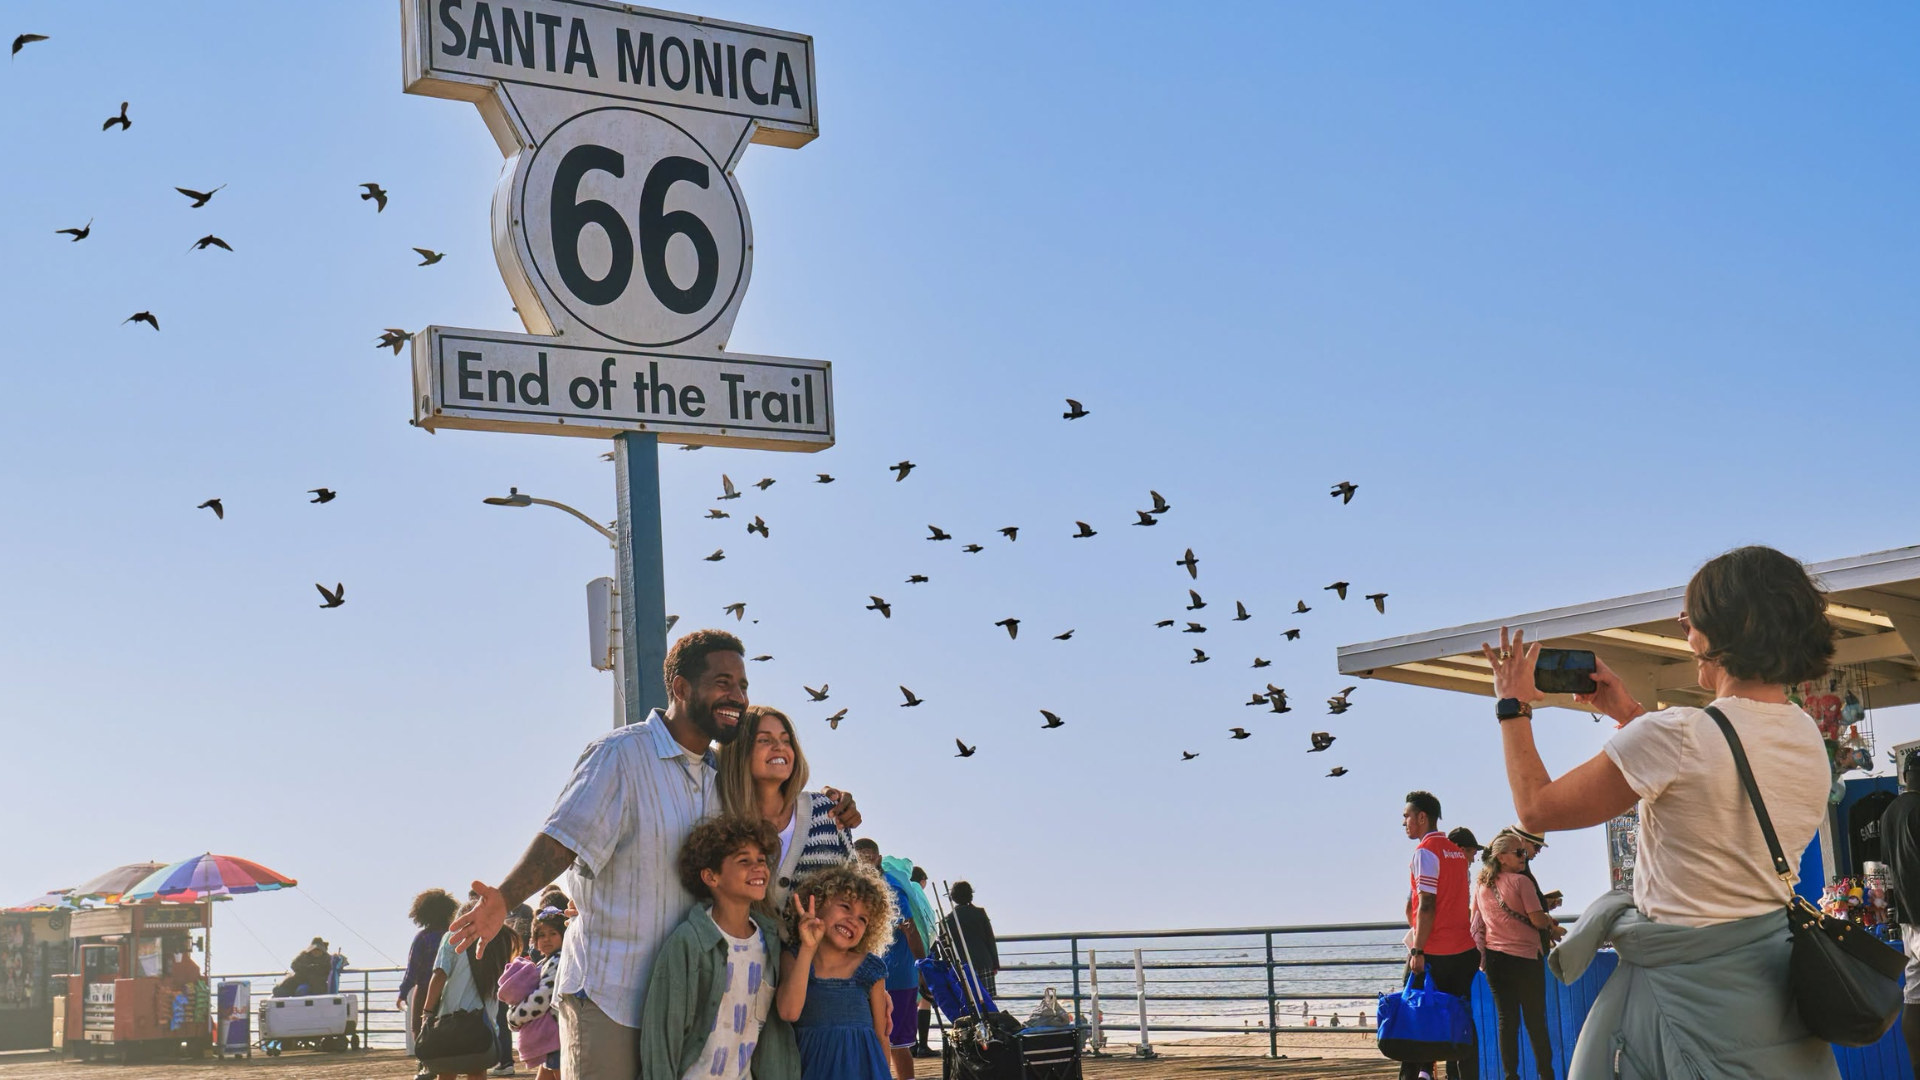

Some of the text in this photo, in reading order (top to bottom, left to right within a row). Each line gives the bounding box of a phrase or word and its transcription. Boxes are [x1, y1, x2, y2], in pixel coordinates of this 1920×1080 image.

[439, 0, 802, 110] SANTA MONICA
[550, 144, 719, 315] 66
[457, 351, 815, 425] End of the Trail
